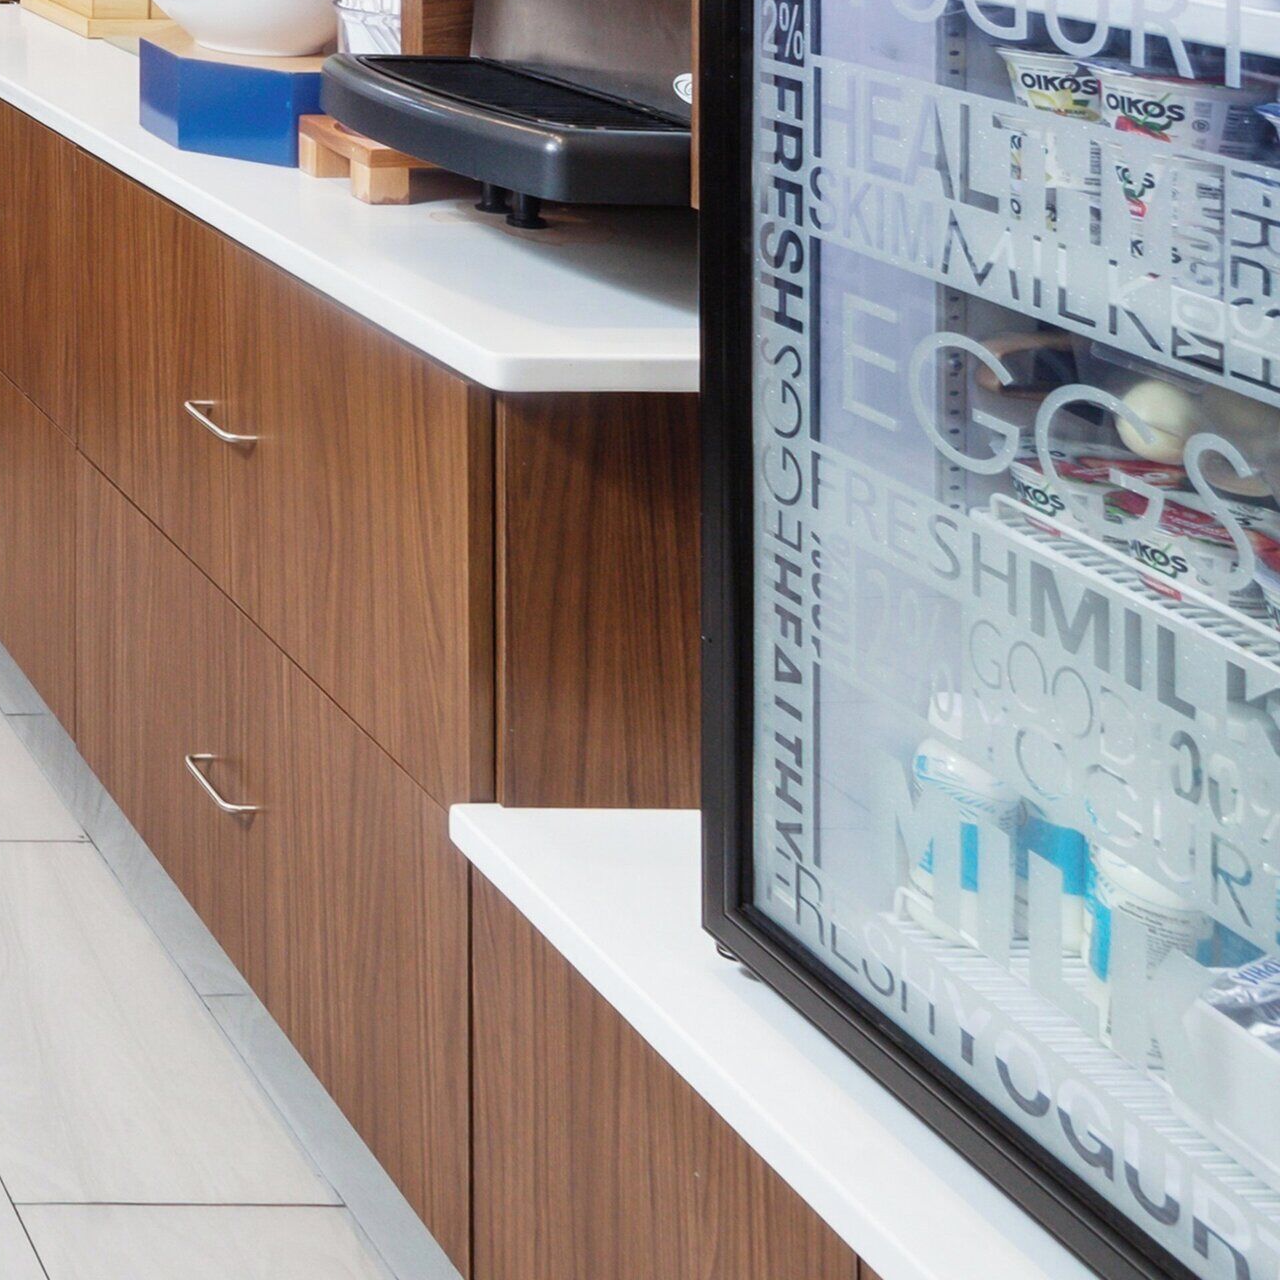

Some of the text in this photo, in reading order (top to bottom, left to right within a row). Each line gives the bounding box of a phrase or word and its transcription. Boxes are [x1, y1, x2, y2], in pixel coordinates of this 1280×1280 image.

[1021, 72, 1098, 96] OIKOS
[1106, 92, 1186, 122] OIKOS
[760, 70, 805, 334] FRESH
[942, 206, 1165, 355] MILK
[842, 289, 1256, 593] EGGS
